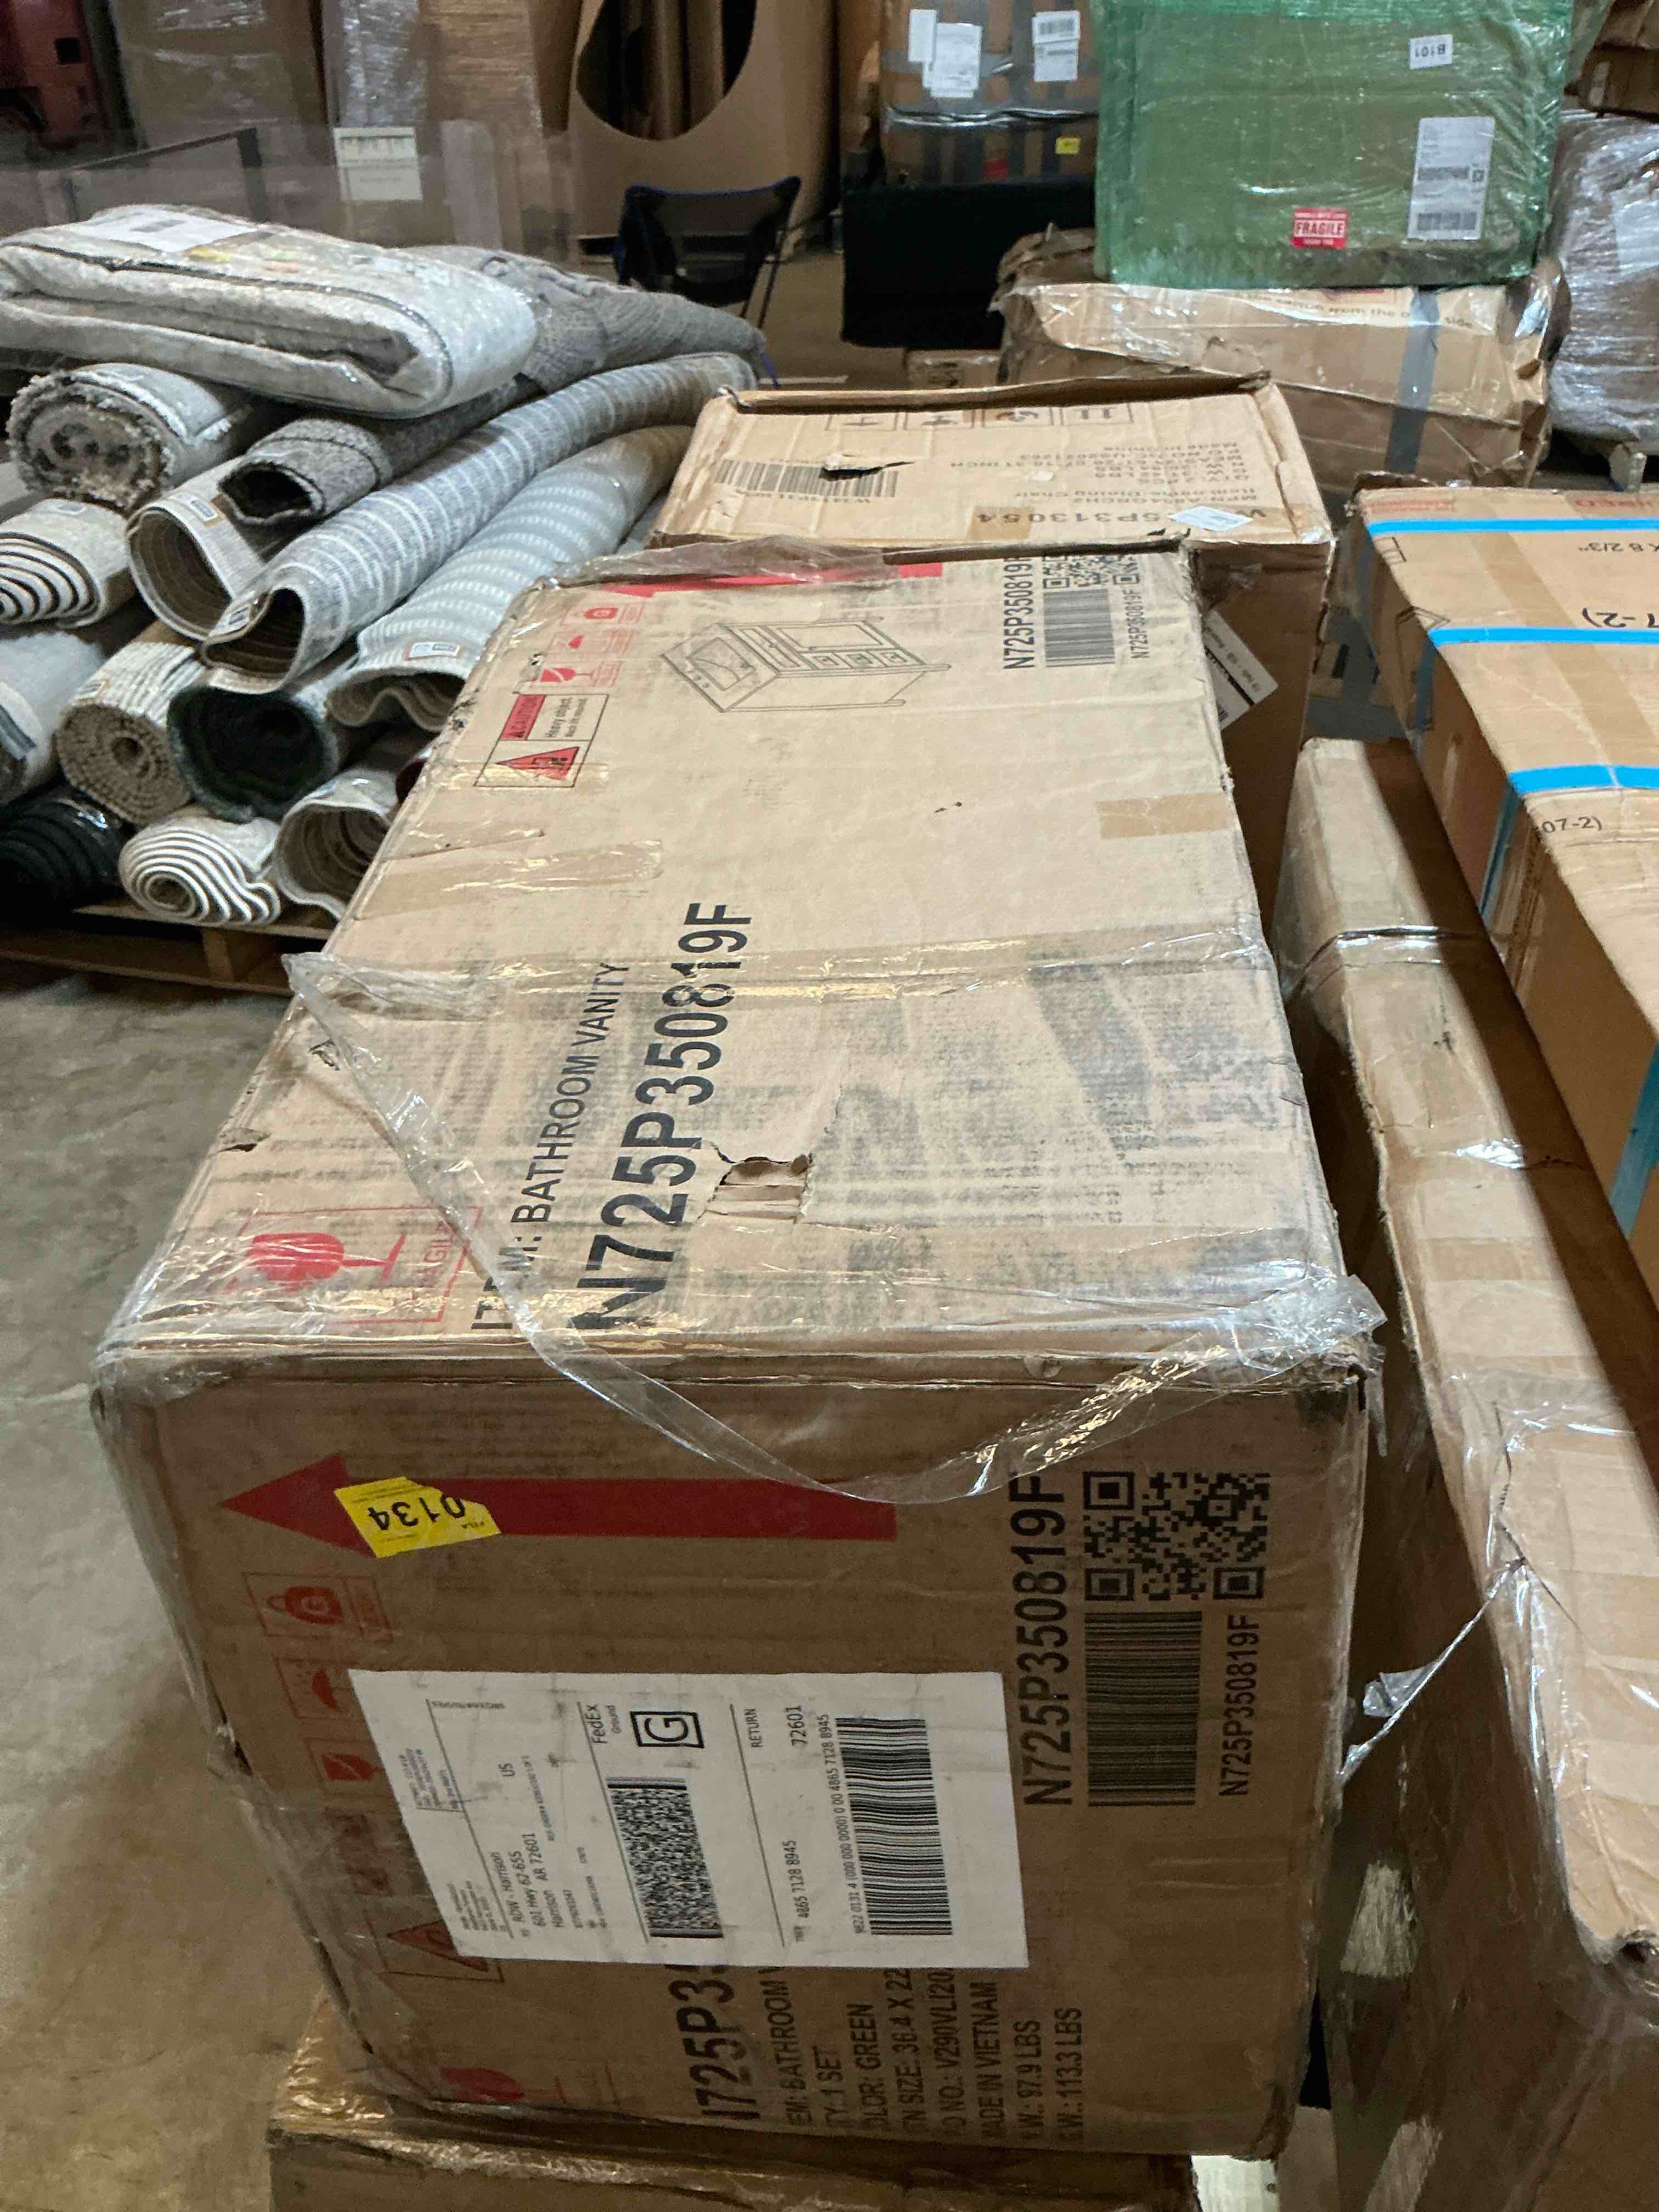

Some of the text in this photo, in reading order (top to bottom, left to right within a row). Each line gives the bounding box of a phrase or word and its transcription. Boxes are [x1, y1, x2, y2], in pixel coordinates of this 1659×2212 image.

[1294, 221, 1344, 235] FRAGILE
[569, 902, 752, 1330] N725P350819F
[471, 962, 631, 1330] ITM: BATHROOM VANITY
[368, 1493, 466, 1531] 0134
[1008, 1475, 1072, 1805] N725P350819F
[581, 1703, 608, 1743] FedEx
[605, 1705, 623, 1734] Ground
[1218, 1613, 1261, 1796] N725P350819F
[641, 1717, 692, 1742] G
[742, 1708, 764, 1748] RETURN
[782, 1705, 809, 1747] 72601
[496, 1763, 516, 1778] US
[520, 1832, 544, 1864] 72601
[780, 1839, 800, 1865] 8945
[532, 1865, 549, 1881] AR
[787, 1868, 806, 1892] 7128
[522, 1887, 543, 1908] Hwy
[540, 1889, 565, 1928] Harrison
[792, 1895, 811, 1918] 4865
[885, 1996, 915, 2010] X
[667, 1965, 761, 2120] 725P3
[759, 1979, 805, 2090] BATHROOM
[844, 2002, 882, 2070] GREEN
[968, 1980, 1002, 2070] VIETNAM
[1011, 2018, 1043, 2058] LBS
[1051, 2006, 1084, 2046] LBS
[810, 2044, 844, 2082] SET
[973, 2073, 1004, 2091] IN
[1013, 2062, 1043, 2098] 97.9
[1051, 2050, 1085, 2098] 113.3
